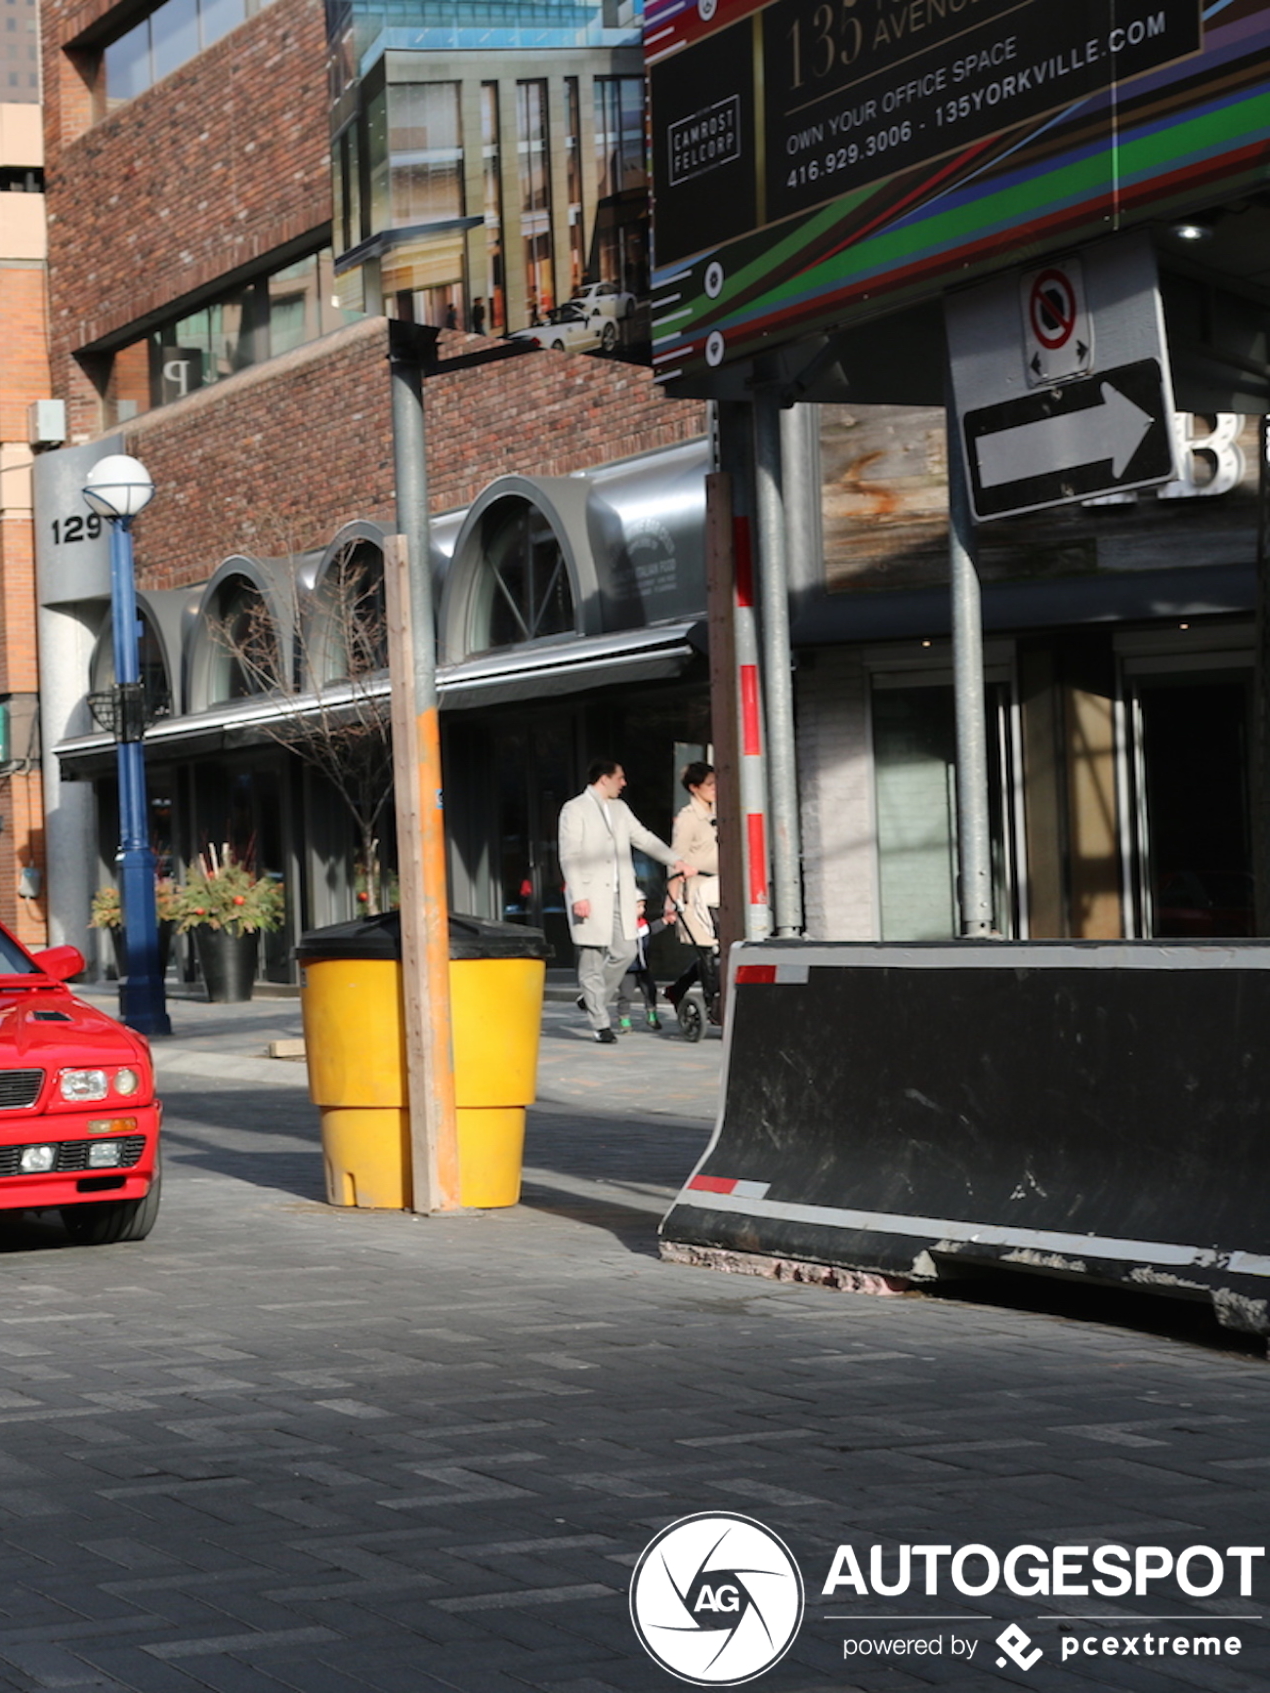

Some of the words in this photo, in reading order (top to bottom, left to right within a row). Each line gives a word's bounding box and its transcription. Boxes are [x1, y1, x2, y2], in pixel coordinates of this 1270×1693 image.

[787, 0, 863, 90] 135
[786, 123, 824, 155] OWN
[829, 100, 877, 136] YOUR
[882, 67, 947, 113] OFFICE
[952, 36, 1017, 82] SPACE
[786, 120, 912, 188] 416.929.3006
[935, 11, 1166, 127] 135YORKVILLE.COM
[673, 109, 733, 151] CAMROST
[674, 131, 734, 173] FELCORP
[52, 513, 102, 546] 129
